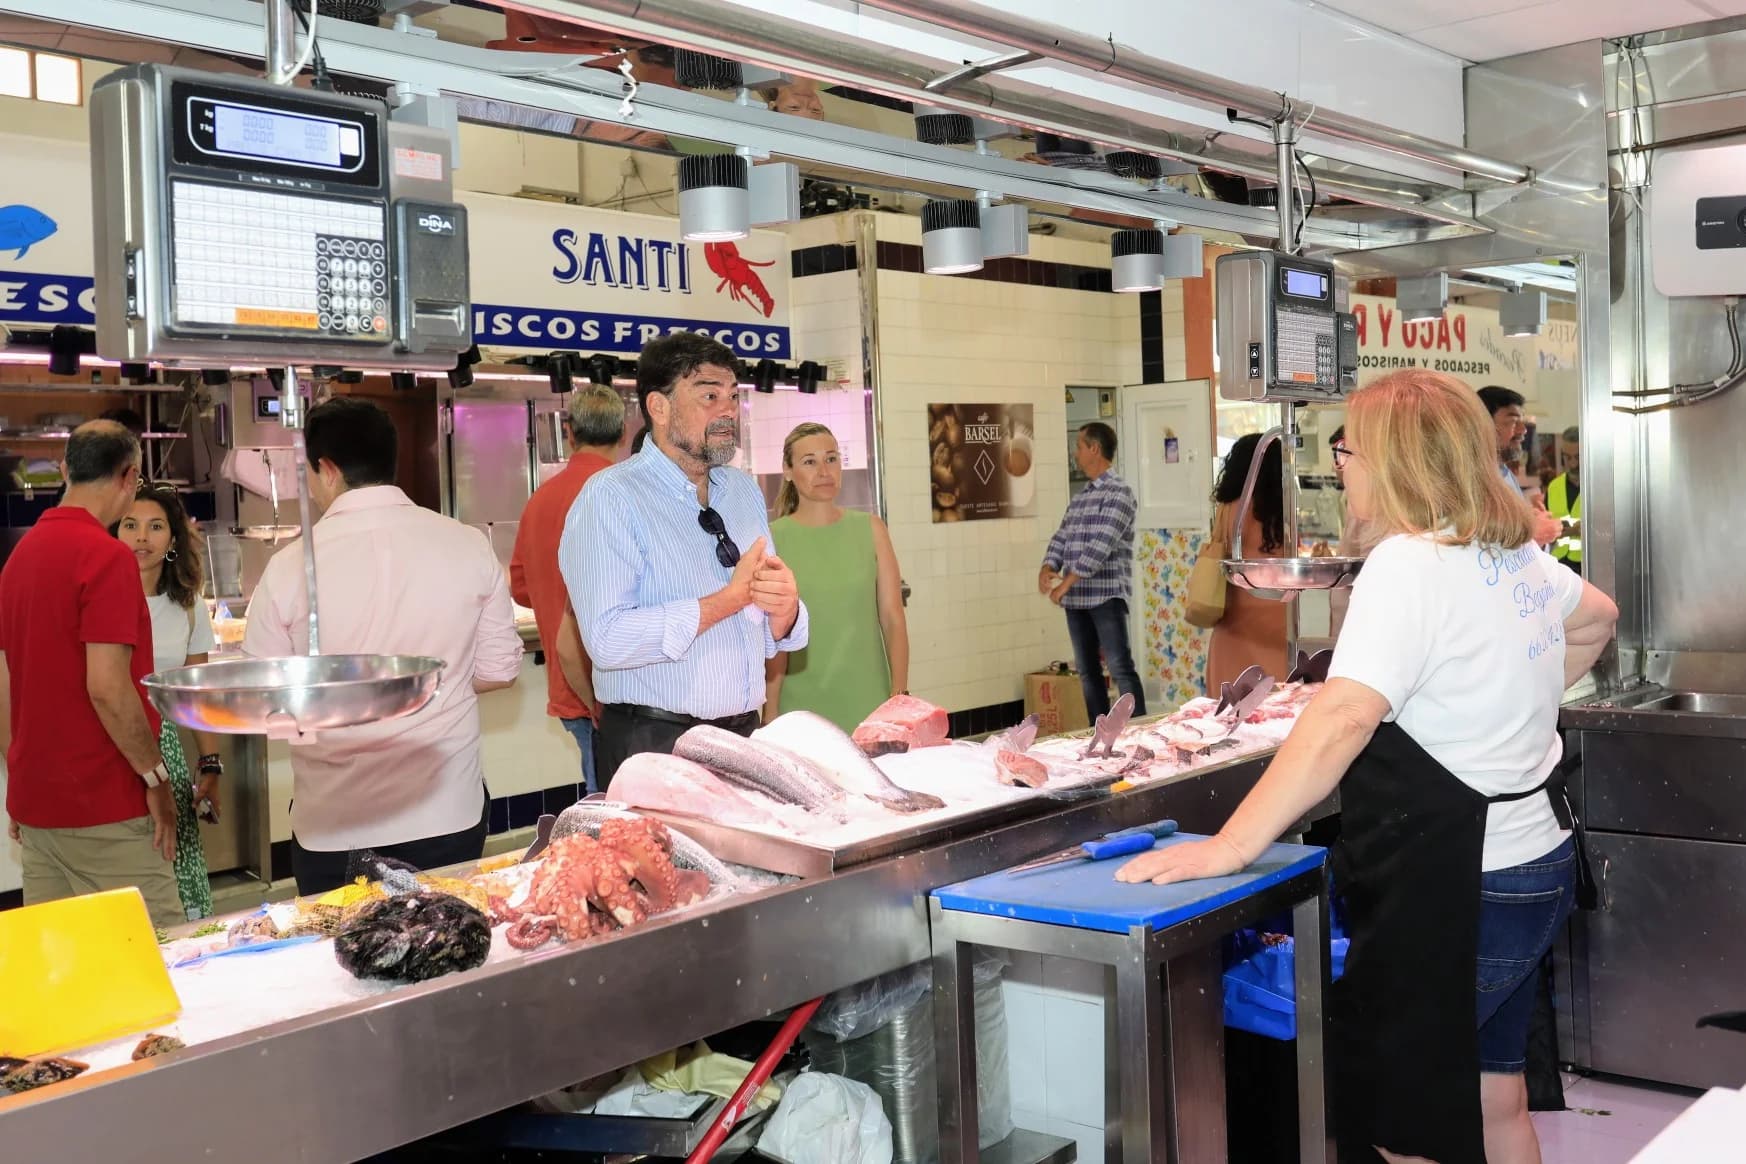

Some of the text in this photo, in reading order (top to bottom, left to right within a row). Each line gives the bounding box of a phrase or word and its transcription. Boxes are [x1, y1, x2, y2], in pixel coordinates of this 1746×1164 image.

[419, 215, 453, 232] DINA
[552, 228, 692, 294] SANTI
[474, 312, 600, 341] ISCOS
[965, 426, 1002, 445] BARSEL
